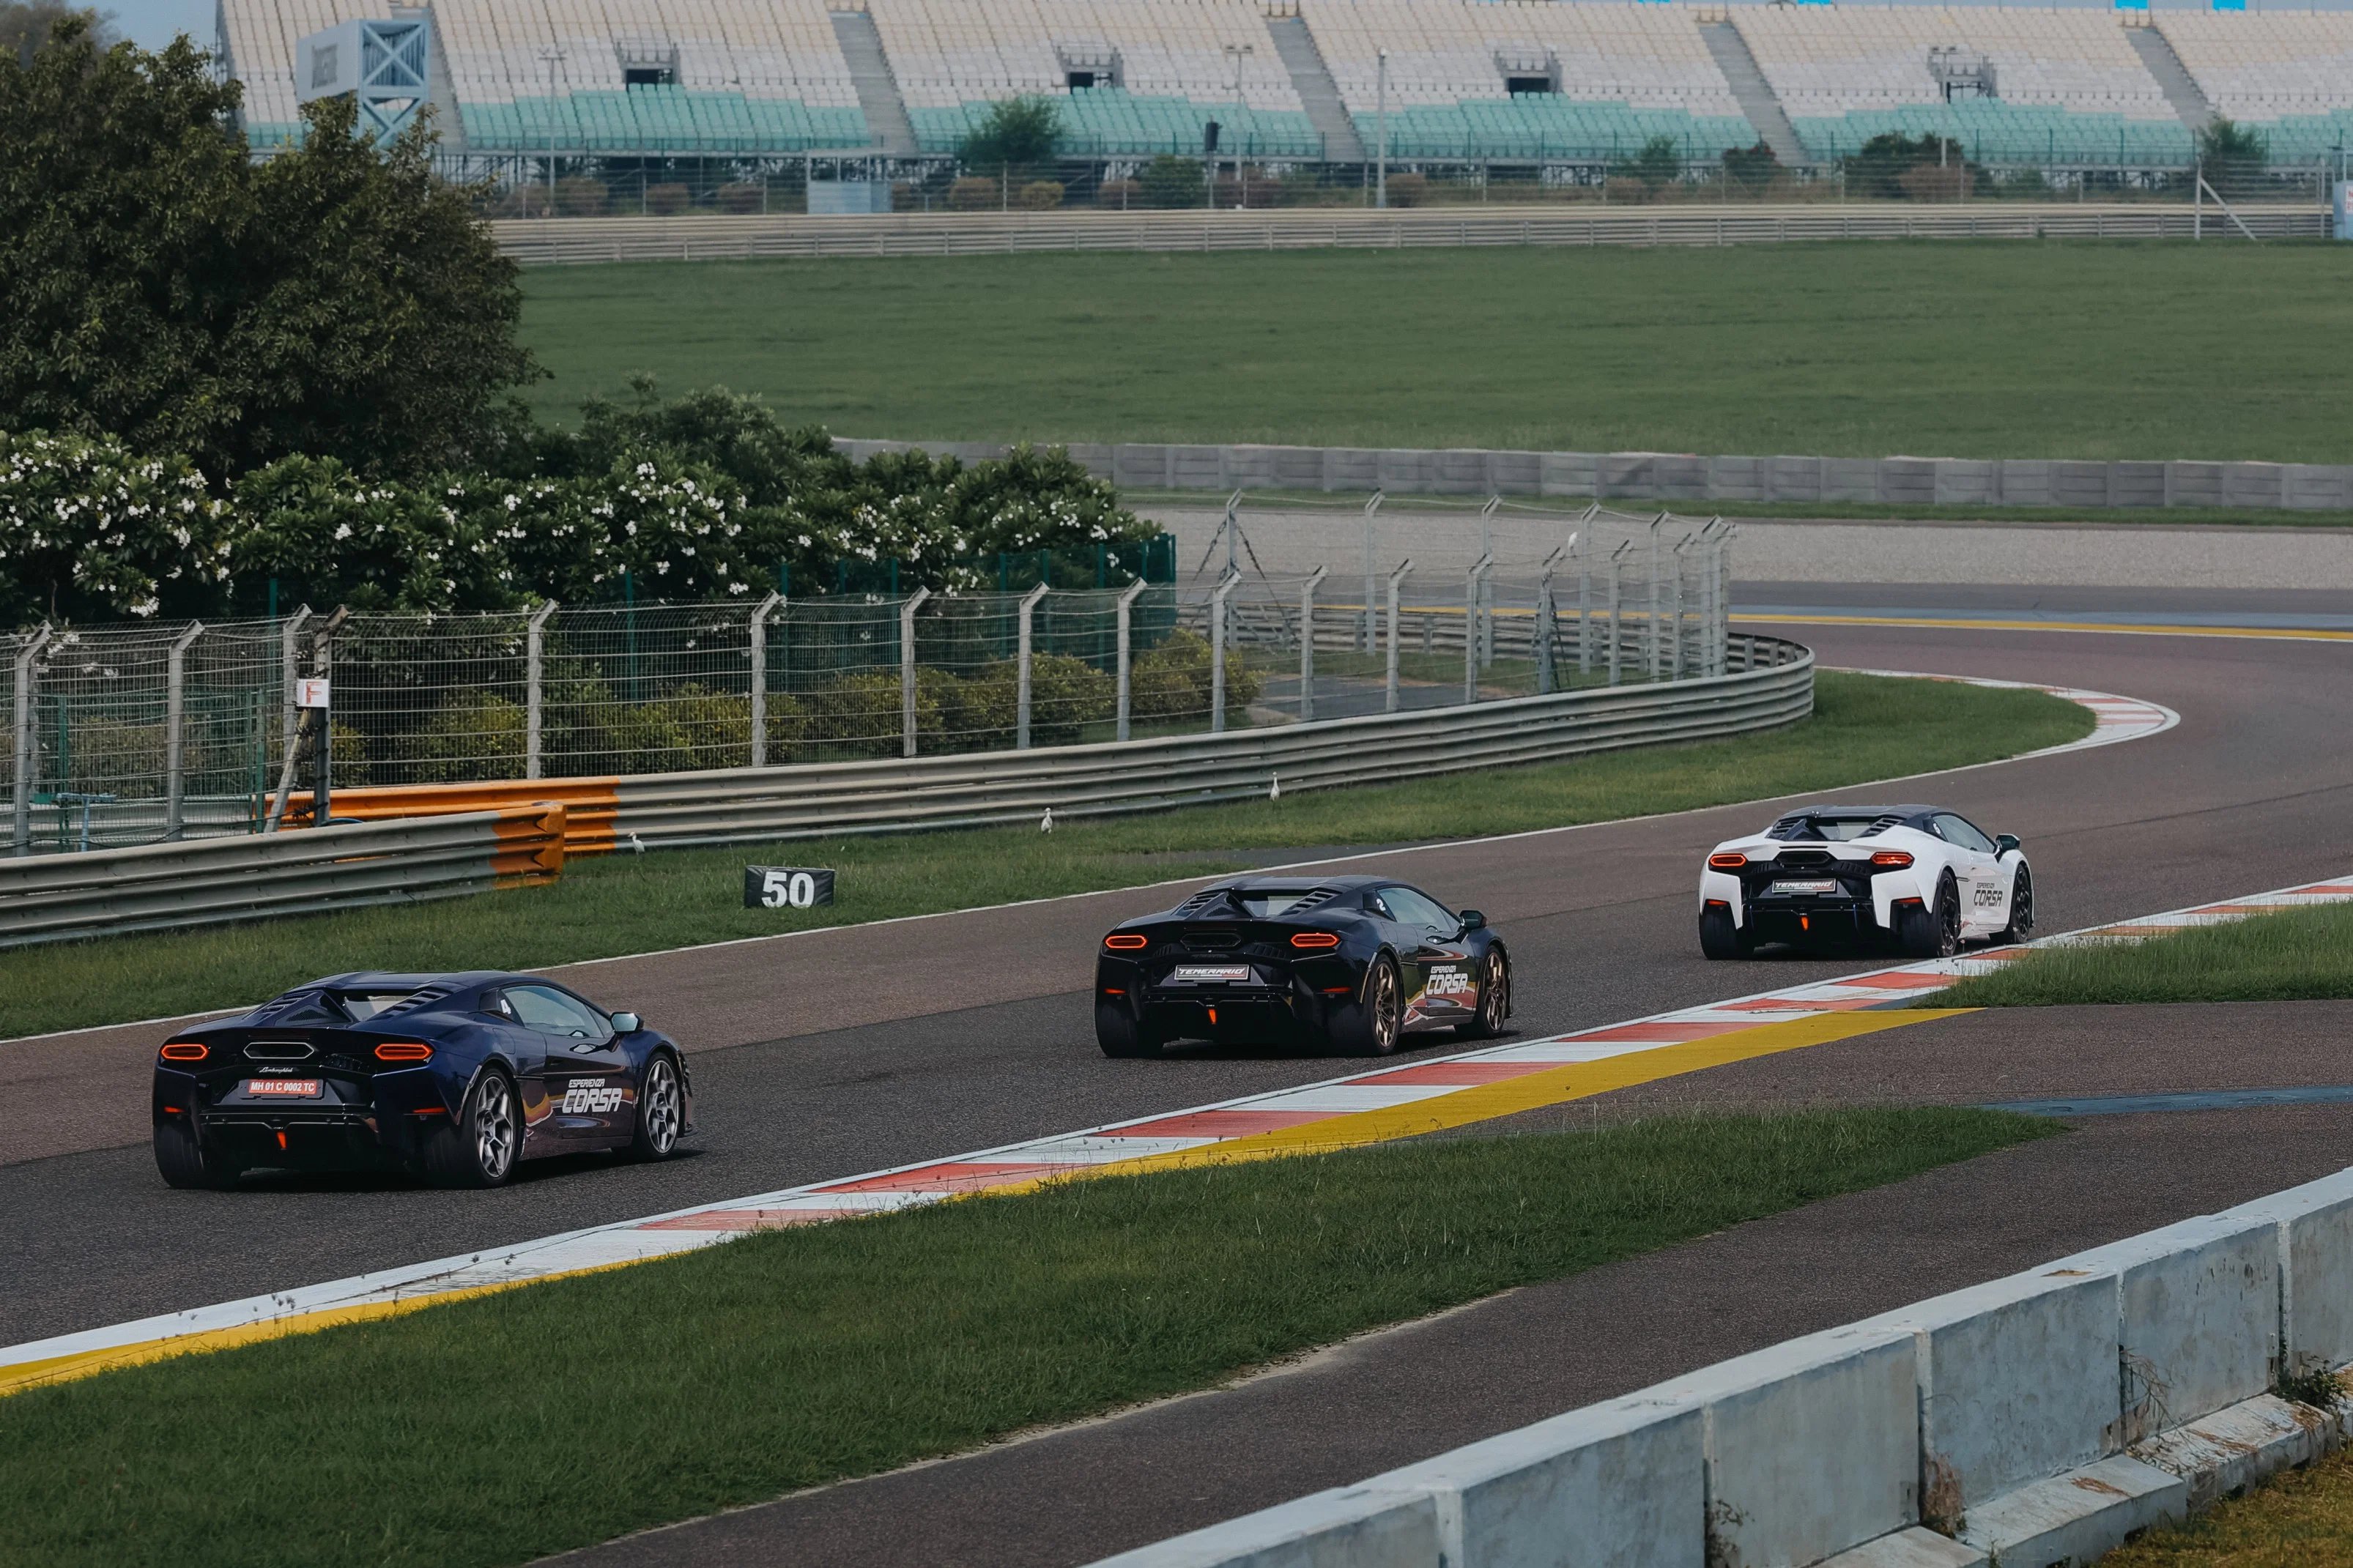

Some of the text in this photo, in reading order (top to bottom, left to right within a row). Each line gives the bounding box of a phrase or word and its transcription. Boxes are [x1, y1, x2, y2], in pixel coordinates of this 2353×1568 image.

[305, 681, 322, 704] F
[762, 872, 815, 908] 50
[1974, 890, 2003, 907] CORSA
[1376, 898, 1386, 911] 2
[1426, 973, 1468, 995] CORSA
[500, 999, 511, 1014] 4
[251, 1082, 315, 1091] MH 01 C 0002 TC
[568, 1079, 605, 1088] ESPERIENZA
[562, 1088, 623, 1113] CORSA
